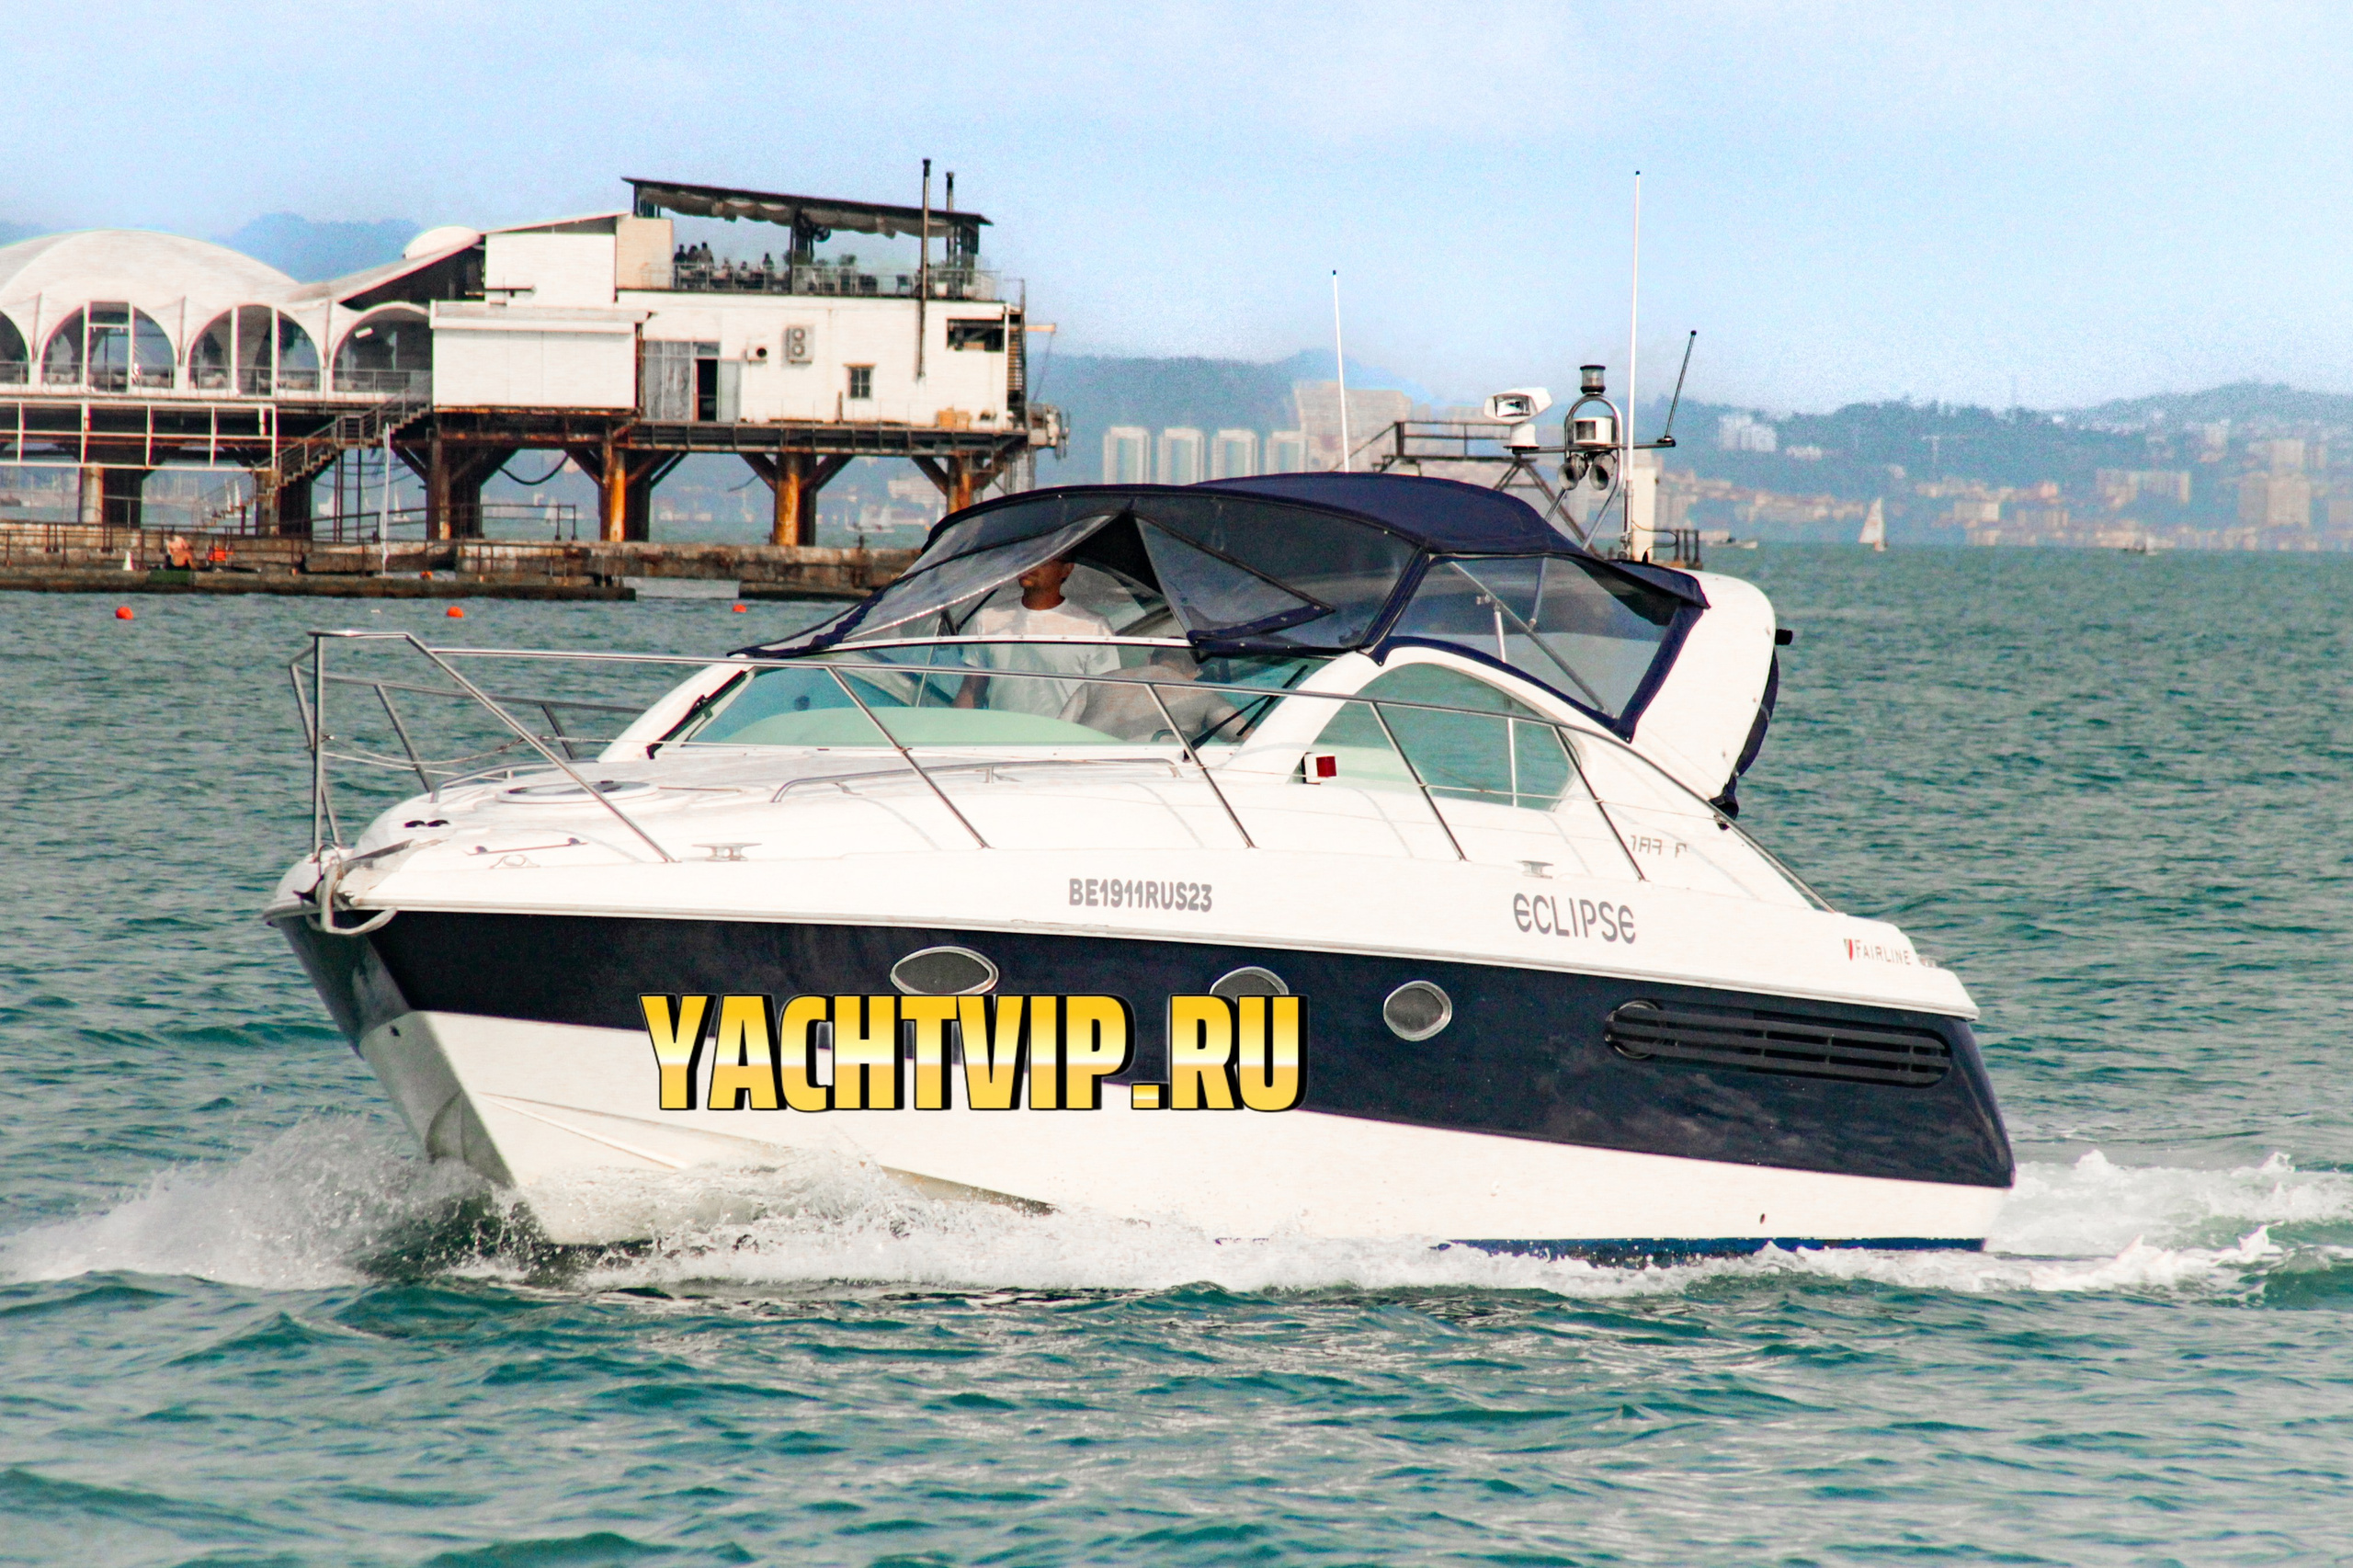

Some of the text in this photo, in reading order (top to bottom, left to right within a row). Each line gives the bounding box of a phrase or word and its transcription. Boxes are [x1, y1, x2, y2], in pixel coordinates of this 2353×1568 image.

[1069, 878, 1212, 913] BE1911RUS23
[1513, 892, 1636, 945] ECLIPSE
[1854, 938, 1912, 966] FAIRLINE
